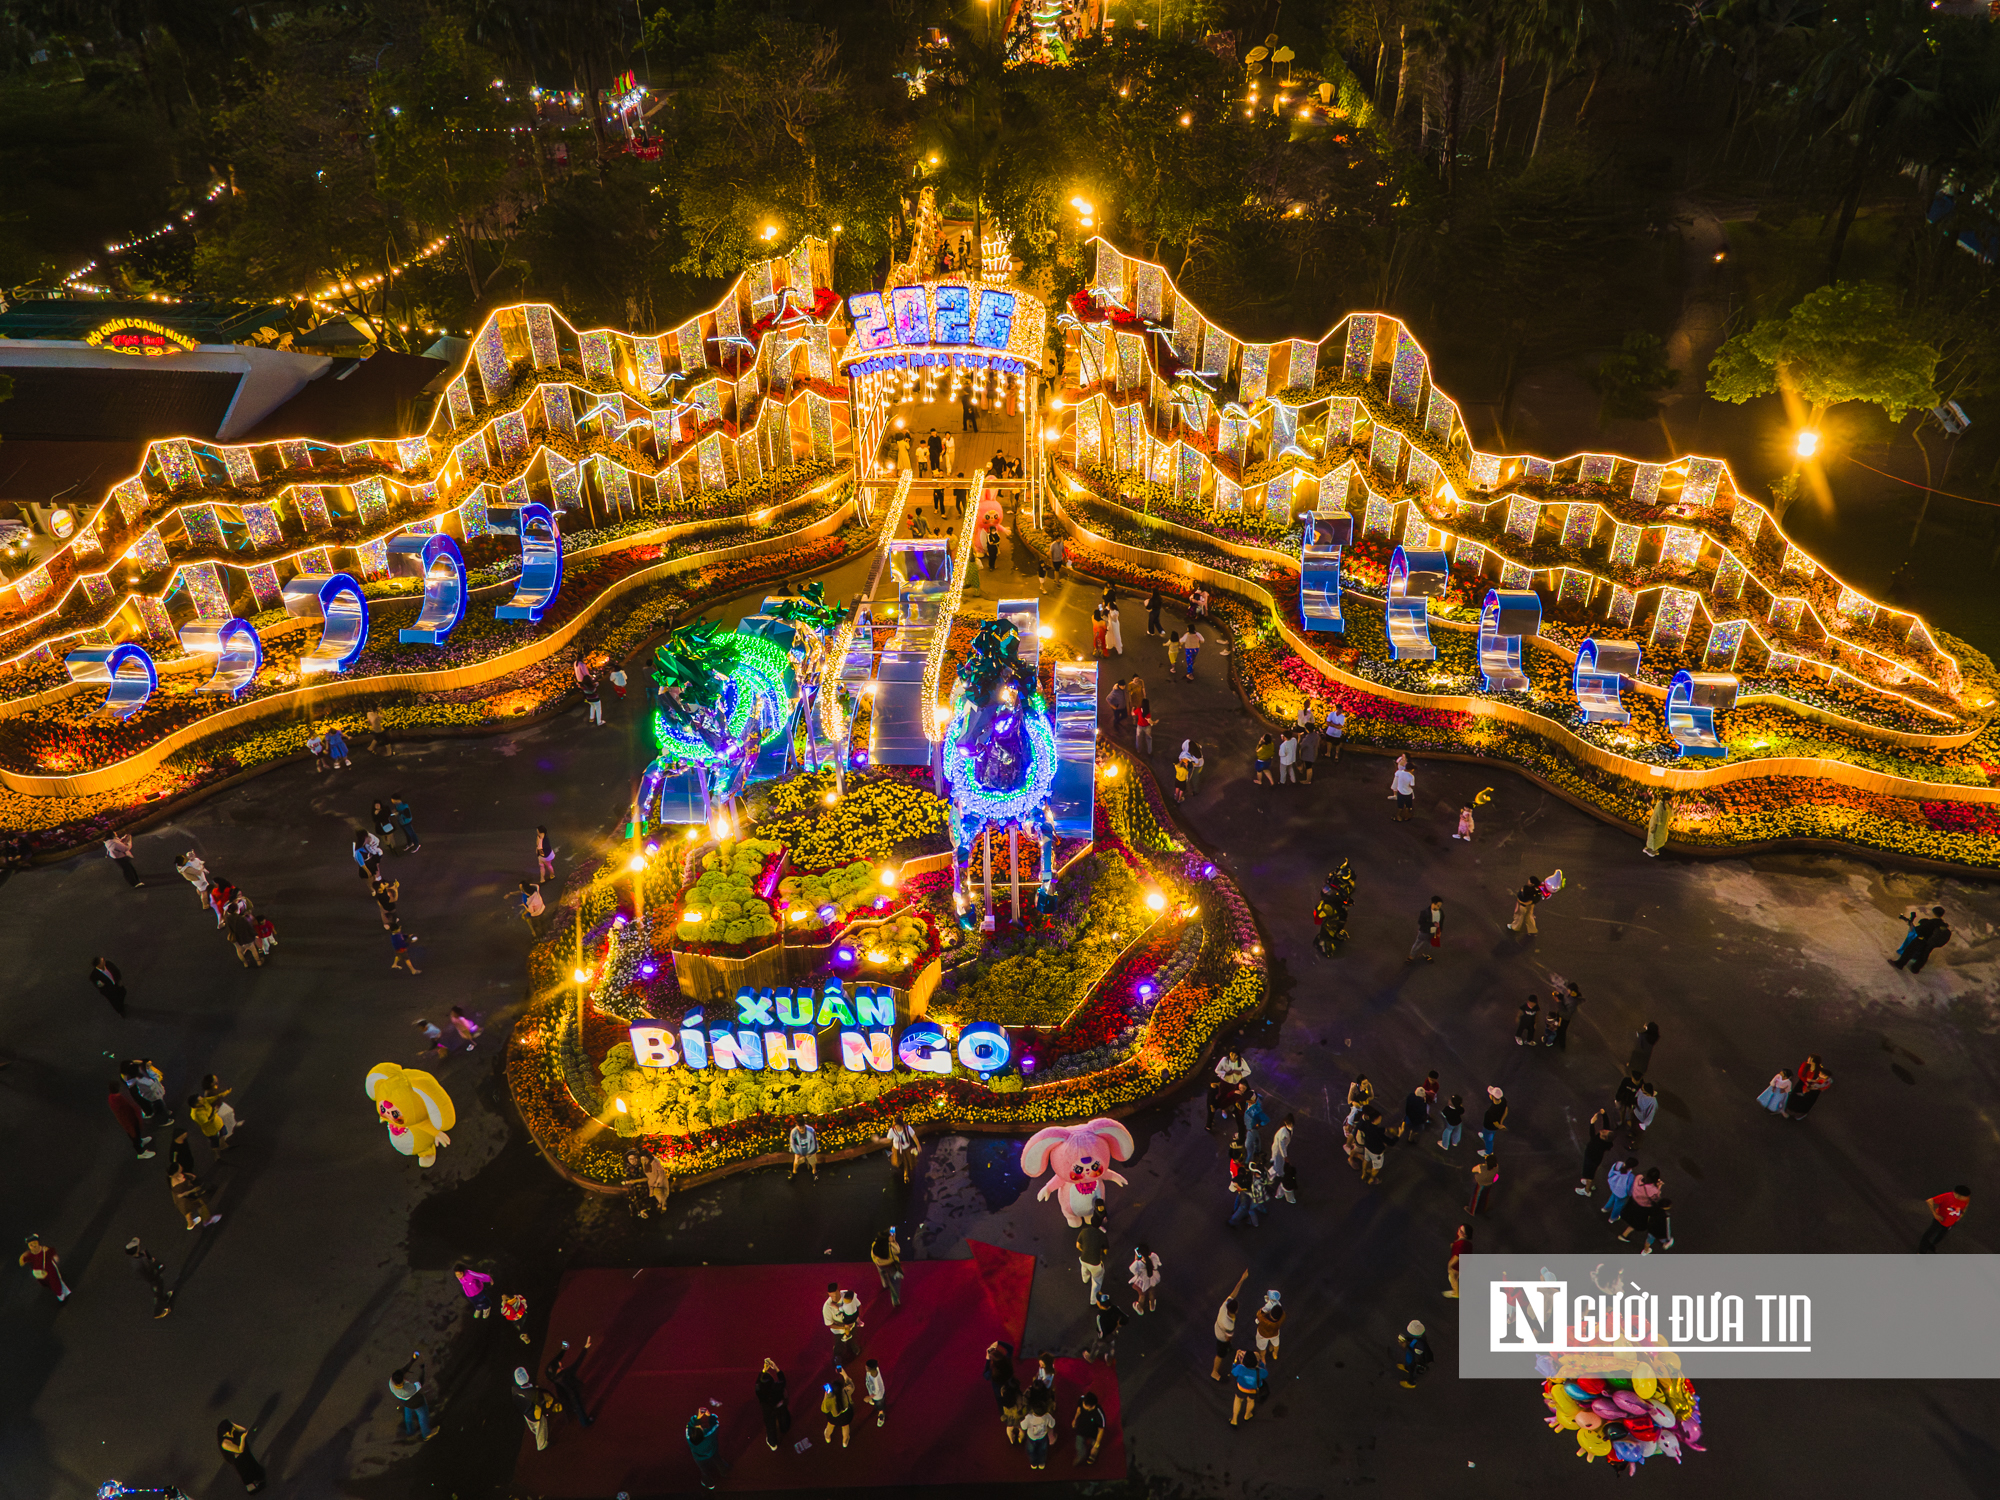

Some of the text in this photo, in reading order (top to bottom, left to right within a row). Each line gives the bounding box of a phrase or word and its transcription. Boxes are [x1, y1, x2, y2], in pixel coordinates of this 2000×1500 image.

[126, 318, 164, 335] DOANH
[165, 328, 196, 351] NHÂN
[848, 285, 1016, 351] 2026
[909, 353, 950, 367] HOA
[736, 976, 896, 1027] XUÂN
[628, 1006, 1012, 1081] BÍNH NGỌ
